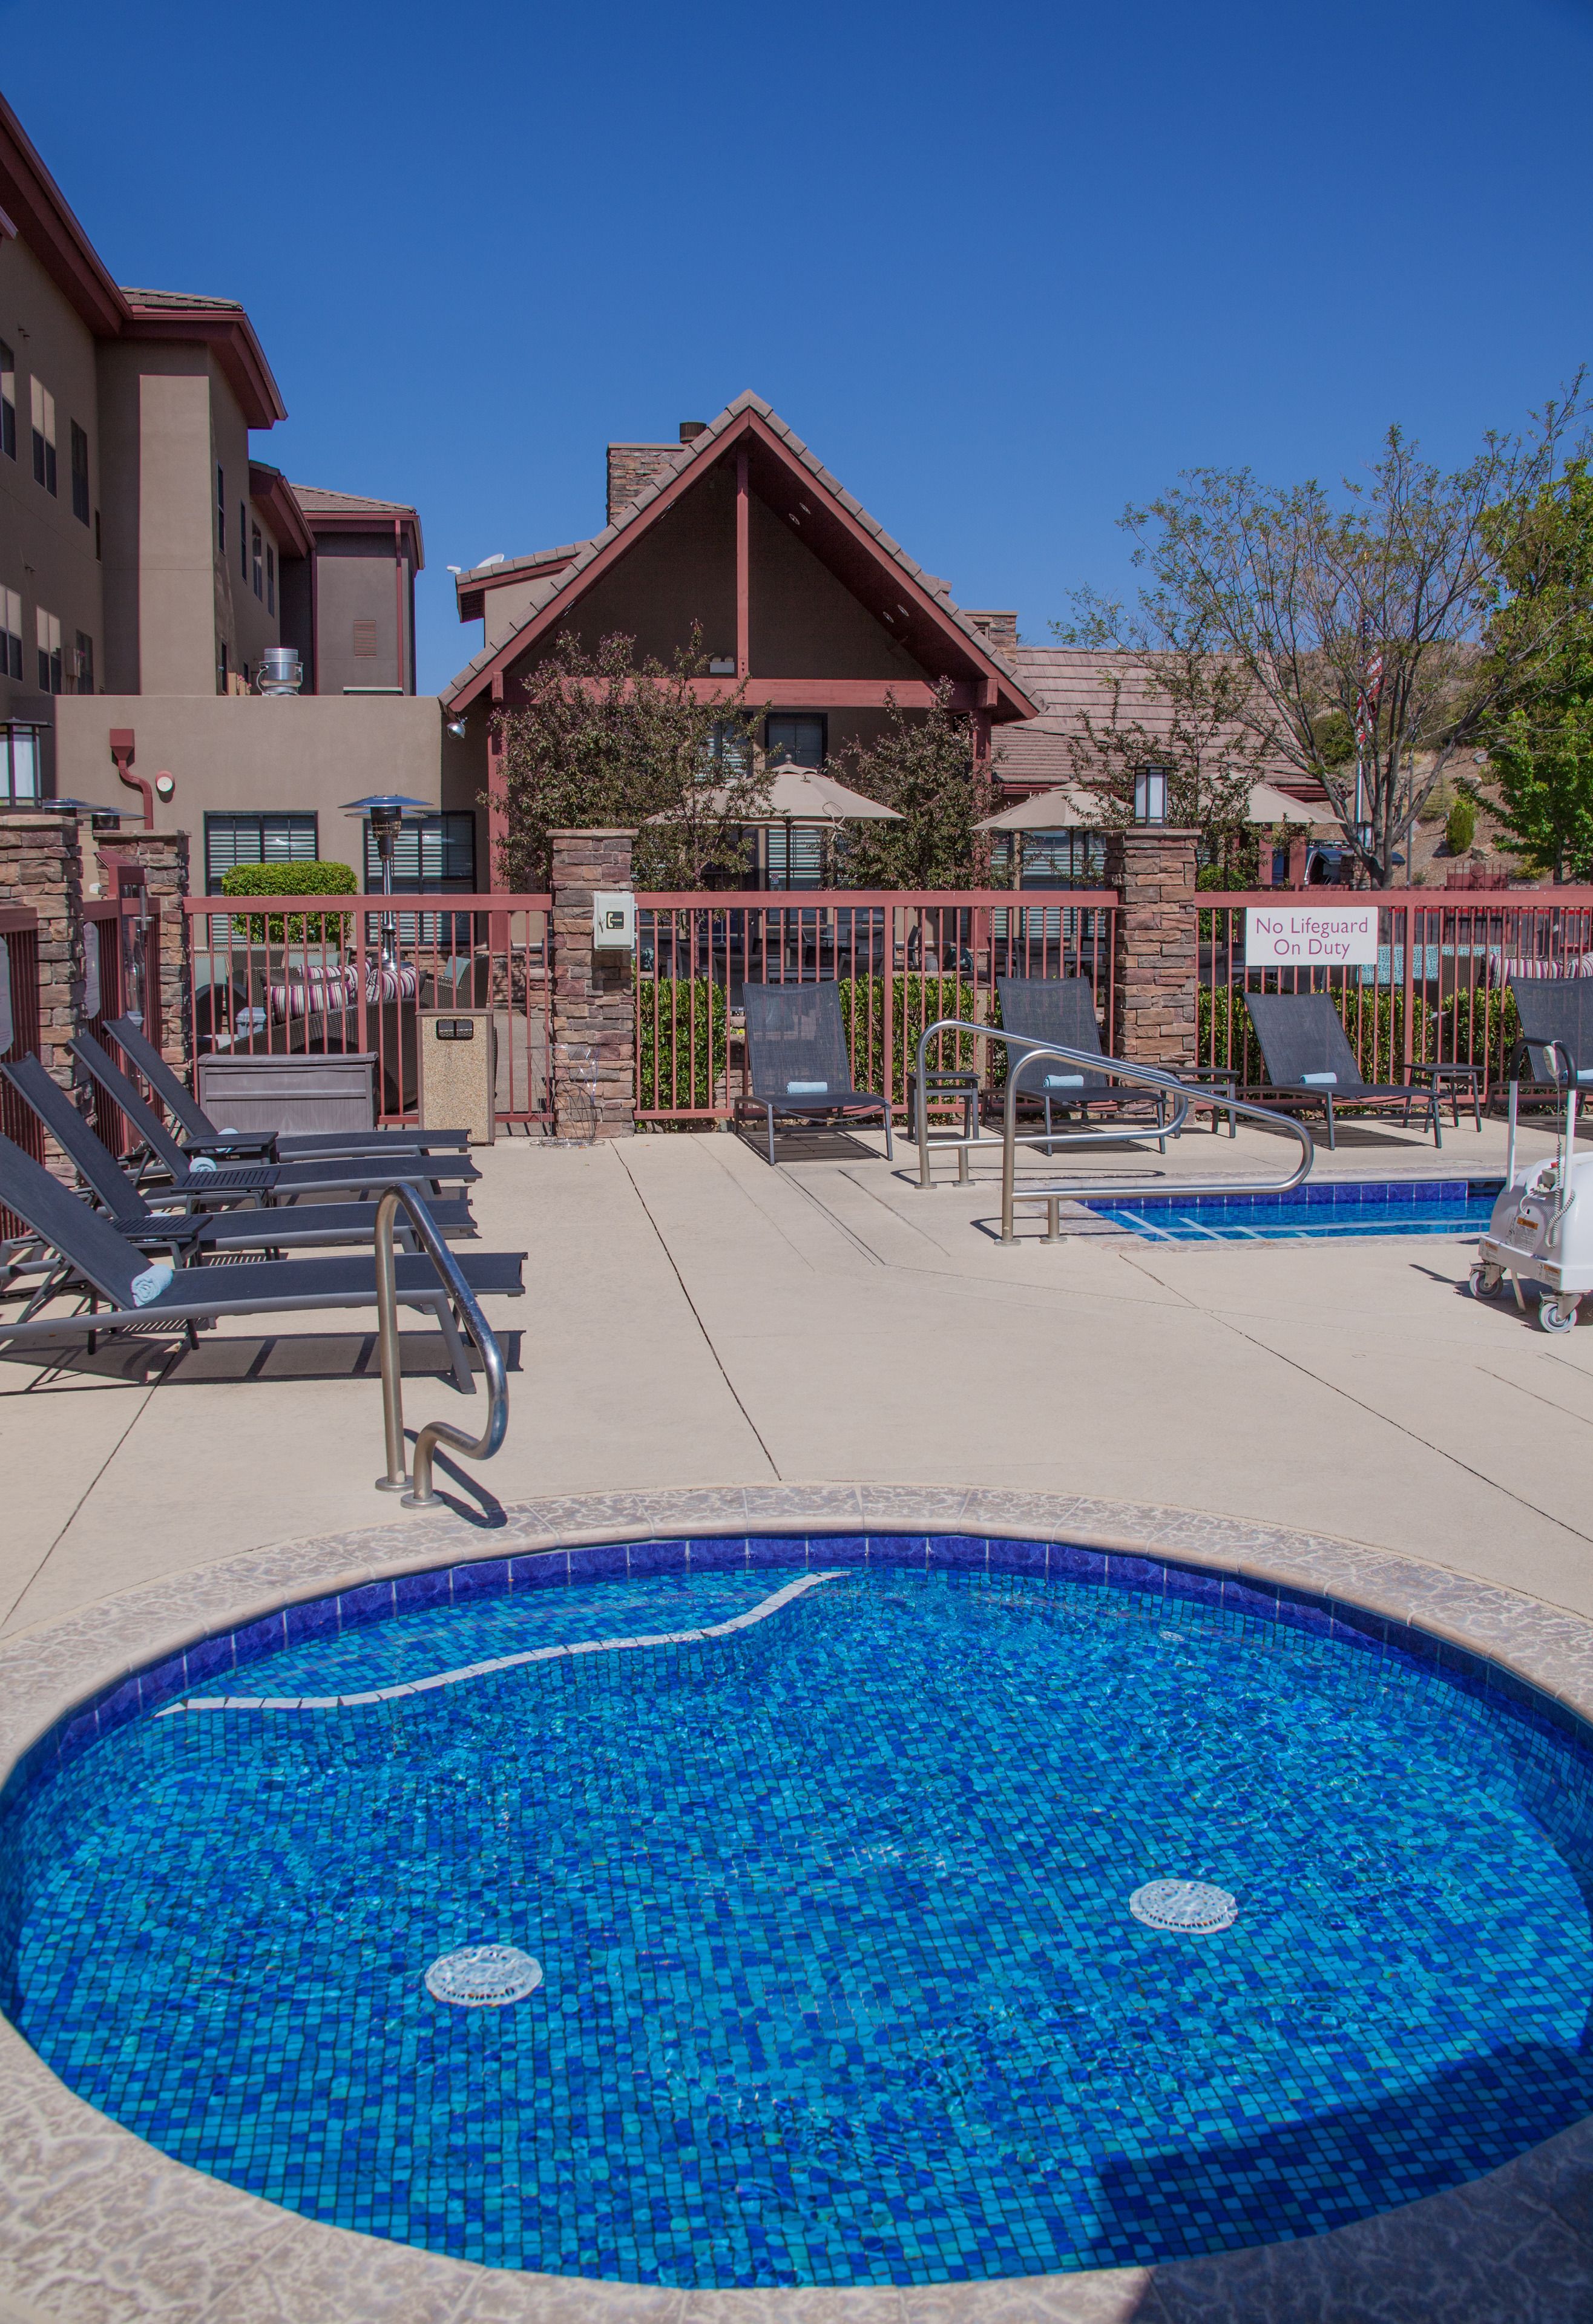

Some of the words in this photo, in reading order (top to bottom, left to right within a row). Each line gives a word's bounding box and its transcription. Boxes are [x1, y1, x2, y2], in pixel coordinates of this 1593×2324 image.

[1256, 917, 1283, 933] No
[1291, 917, 1368, 938] Lifeguard
[1274, 939, 1301, 955] On
[1309, 939, 1350, 959] Duty
